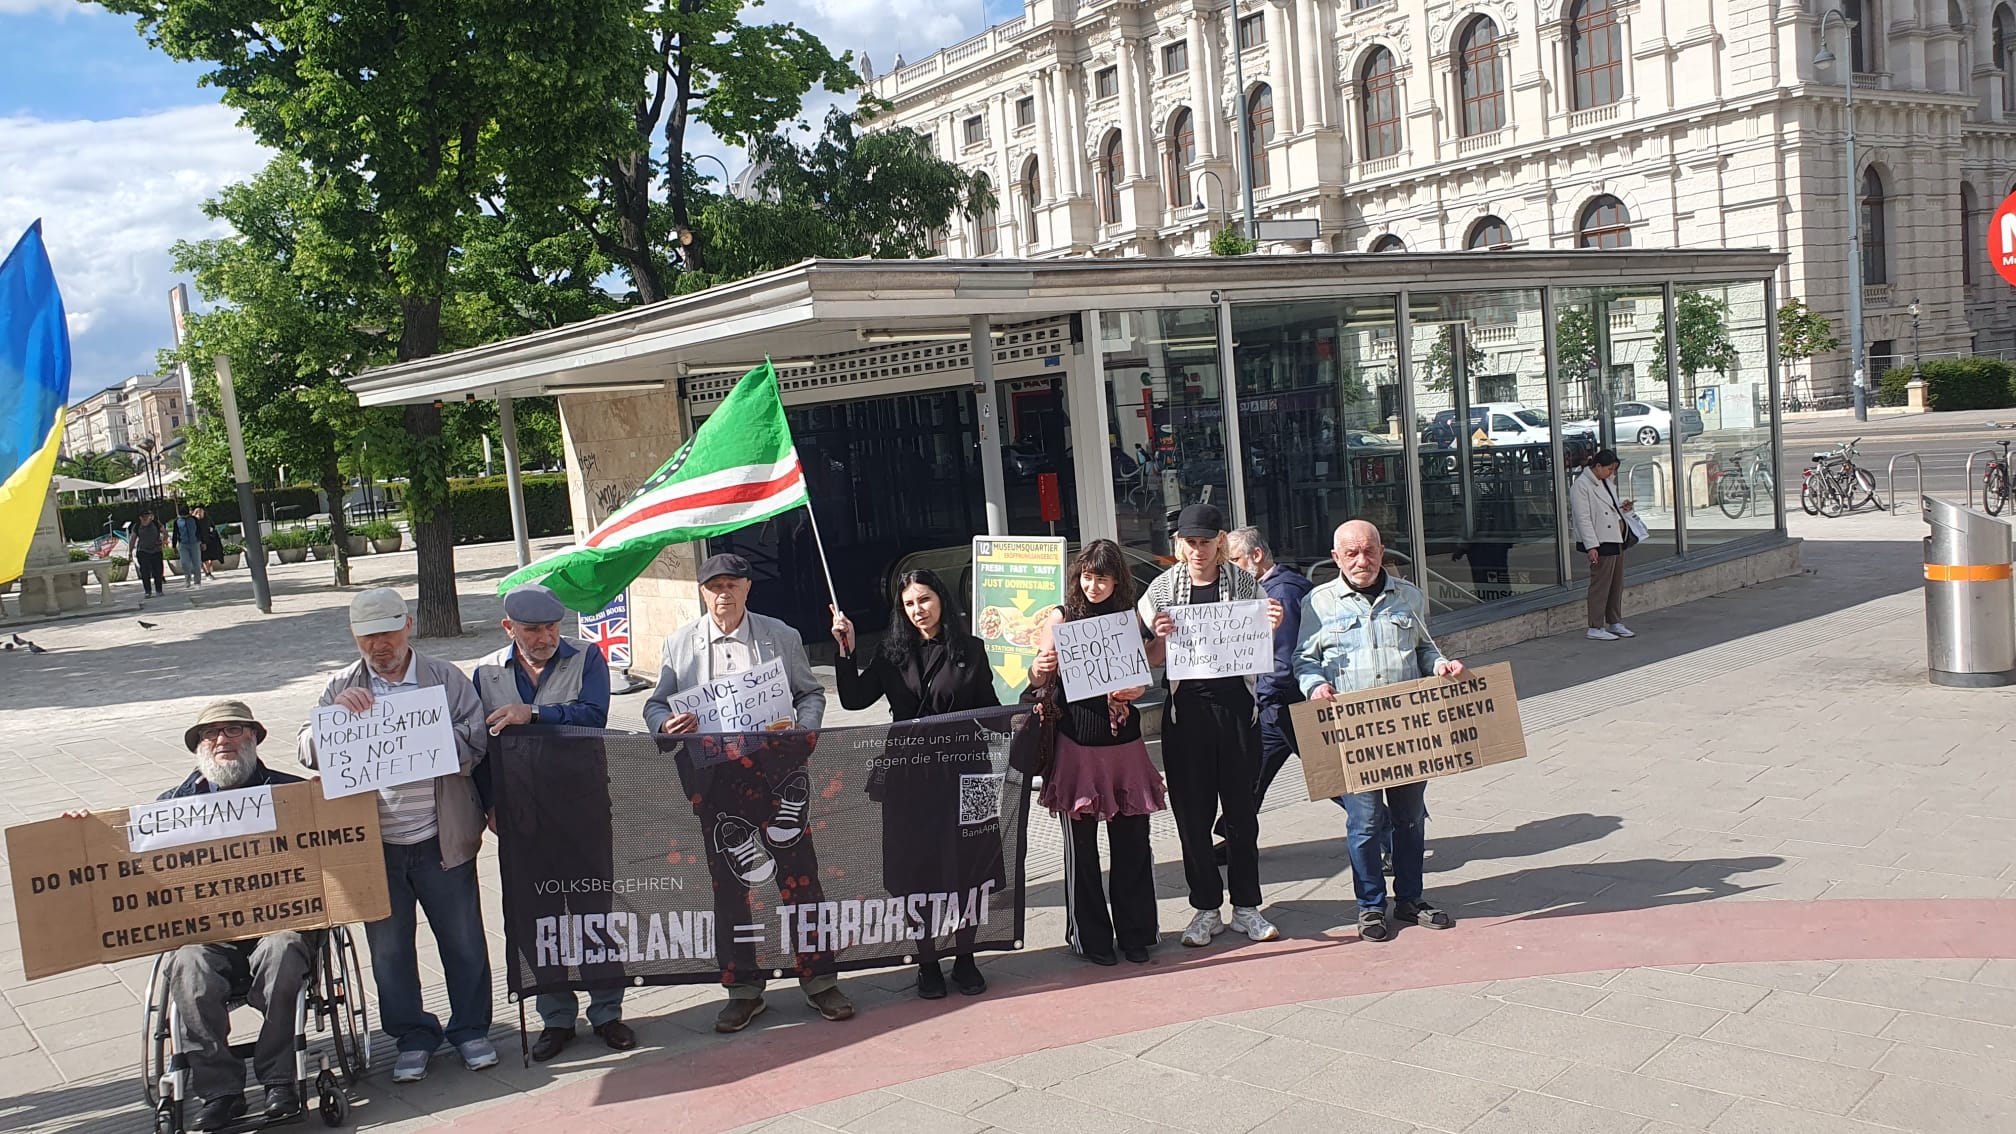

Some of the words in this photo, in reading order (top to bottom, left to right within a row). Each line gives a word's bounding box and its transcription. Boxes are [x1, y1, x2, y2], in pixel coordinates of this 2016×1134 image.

[980, 542, 990, 555] U2
[993, 543, 1058, 552] MUSEUMSQUARTIER
[981, 563, 1004, 572] FRESH
[1009, 565, 1027, 573] FAST
[1033, 565, 1057, 574] TASTY
[982, 579, 1002, 588] JUST
[1005, 579, 1055, 591] DOWNSTAIRS
[580, 611, 606, 623] ENGLISH
[606, 606, 626, 616] BOOKS
[1213, 616, 1253, 632] STOP
[1059, 617, 1110, 646] STOP
[1170, 635, 1207, 650] chain
[1061, 633, 1123, 664] DEPORT
[1174, 654, 1186, 666] to
[1189, 649, 1218, 667] Russia
[1234, 647, 1254, 658] via
[1062, 667, 1080, 684] TO
[1084, 648, 1149, 690] RUSSIA
[674, 695, 700, 714] DO
[743, 662, 781, 689] Send
[1317, 695, 1402, 723] DEPORTING
[1409, 677, 1487, 705] CHECHENS
[320, 706, 442, 749] MOBILISATION
[728, 713, 752, 729] TO
[1321, 719, 1396, 746] VIOLATES
[1402, 712, 1432, 731] THE
[1438, 698, 1495, 724] GENEVA
[328, 750, 351, 768] IS
[367, 736, 407, 763] NOT
[853, 734, 925, 749] unterstütze
[929, 734, 951, 745] uns
[955, 732, 970, 743] im
[974, 730, 1015, 745] Kampf
[1346, 735, 1443, 765] CONVENTION
[1450, 726, 1478, 745] AND
[341, 749, 440, 789] SAFETY
[865, 755, 907, 771] gegen
[911, 753, 931, 764] die
[935, 751, 1002, 763] Terroristen
[1360, 763, 1413, 785] HUMAN
[1419, 752, 1474, 775] RIGHTS
[32, 875, 60, 894] DO
[69, 864, 109, 885] NOT
[118, 858, 145, 877] BE
[152, 839, 260, 873] COMPLICIT
[270, 835, 288, 852] IN
[296, 825, 366, 849] CRIMES
[112, 894, 139, 913] DO
[147, 886, 187, 908] NOT
[194, 867, 306, 900] EXTRADITE
[534, 876, 683, 895] VOLKSBEGEHREN
[102, 916, 211, 949] CHECHENS
[218, 910, 245, 929] TO
[252, 897, 323, 923] RUSSIA
[536, 911, 716, 967] RUSSLAND
[776, 879, 995, 955] TERRORSTAAT
